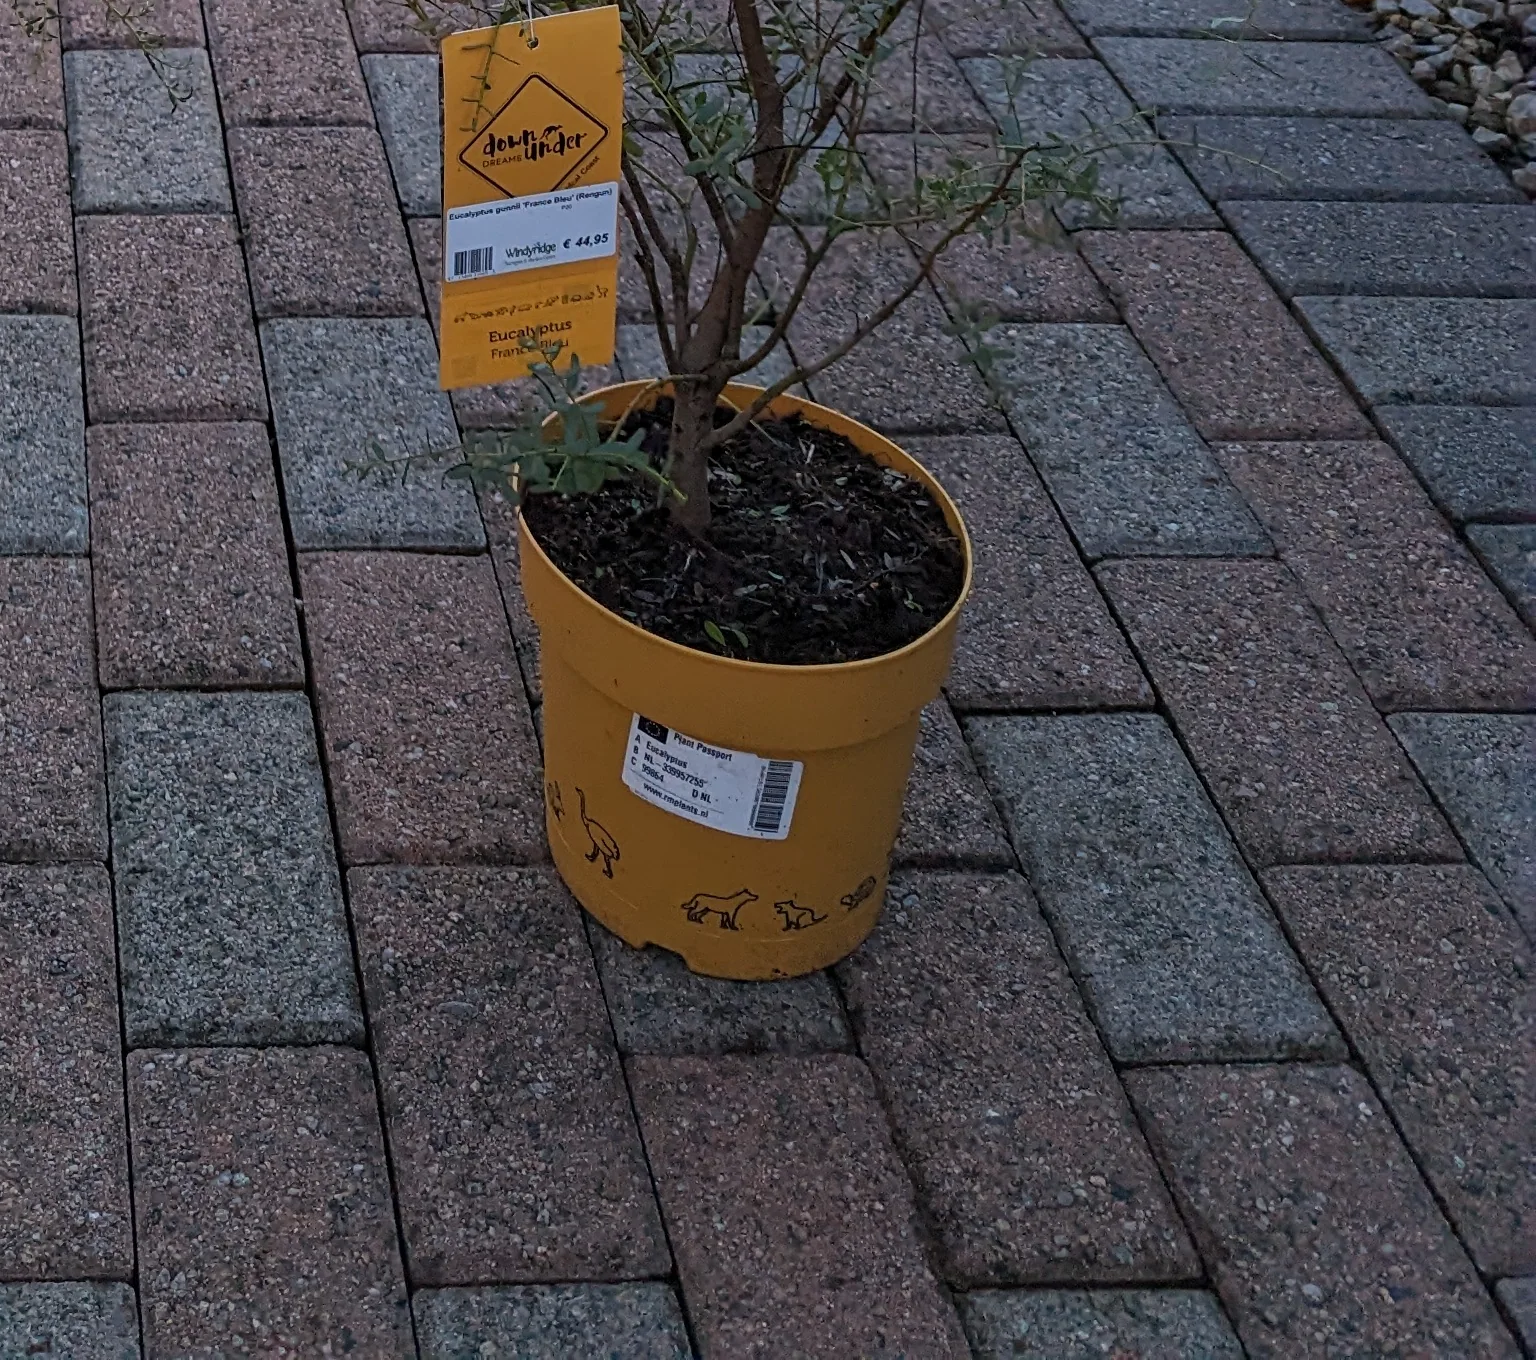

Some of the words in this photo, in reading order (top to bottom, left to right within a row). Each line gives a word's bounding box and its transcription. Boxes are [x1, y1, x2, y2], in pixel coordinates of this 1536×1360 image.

[482, 130, 537, 158] down
[524, 131, 588, 162] under
[482, 154, 523, 169] DREAMS
[580, 155, 601, 175] Coast
[449, 206, 494, 222] Eucalyptus
[505, 241, 557, 260] Windyridge
[563, 238, 572, 249] €
[575, 232, 609, 249] 44,95
[488, 320, 573, 343] Eucalyptus
[633, 745, 639, 755] B
[634, 734, 641, 745] A
[645, 740, 688, 769] Eucalyptus
[673, 732, 695, 750] Plant
[696, 742, 733, 762] Passport
[630, 756, 637, 767] C
[700, 792, 712, 804] NL
[642, 782, 710, 819] www.rmplants.nl
